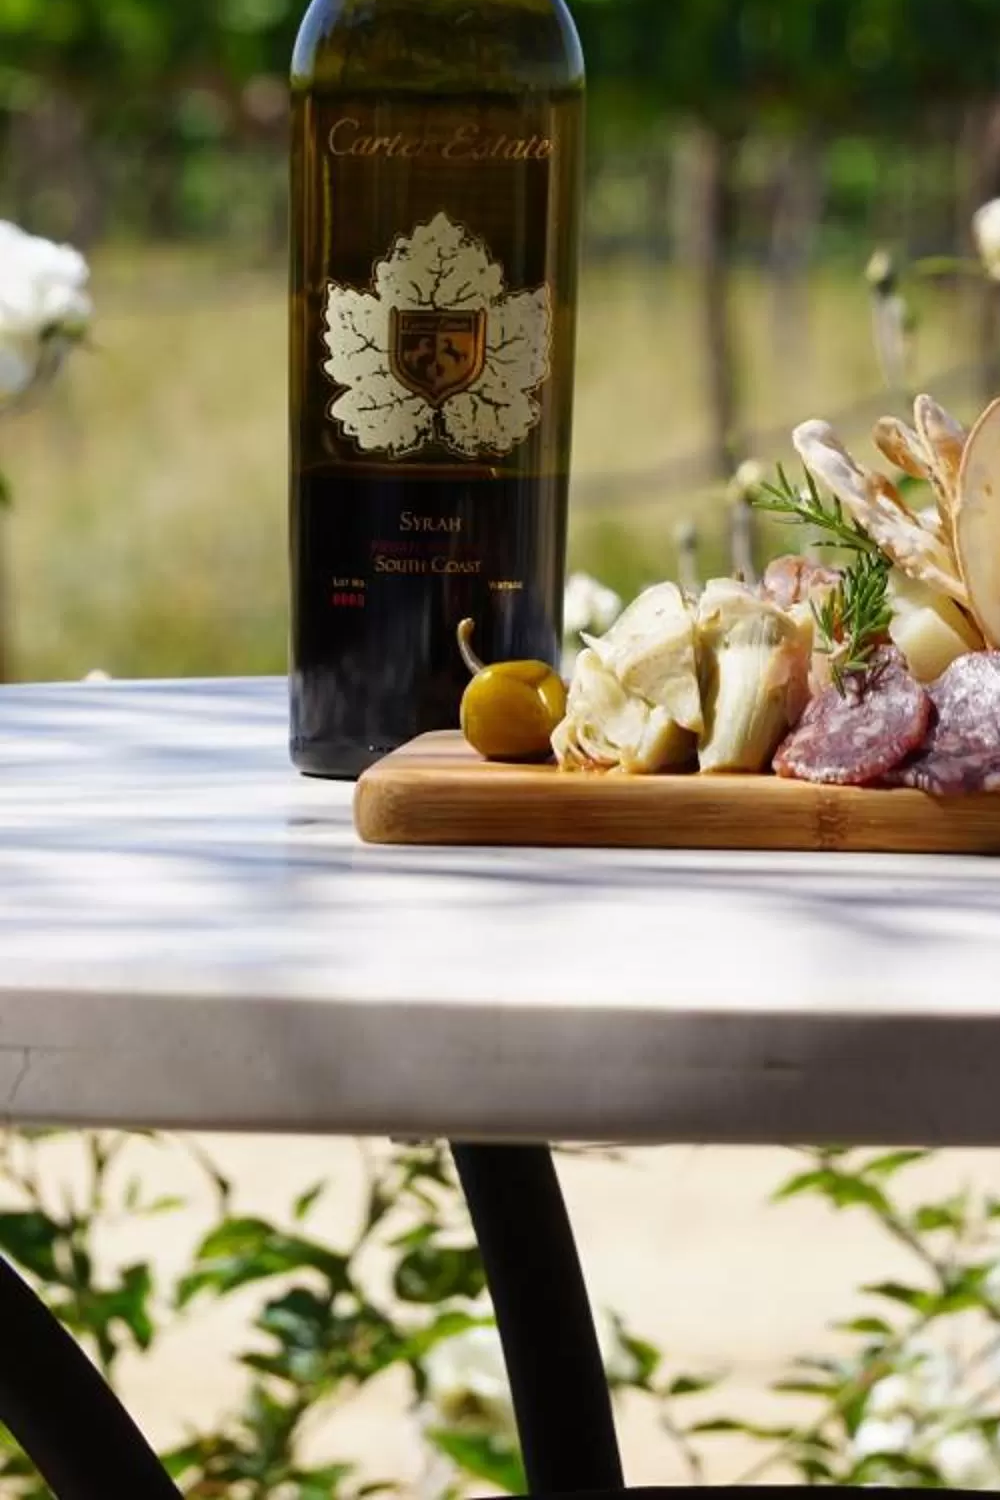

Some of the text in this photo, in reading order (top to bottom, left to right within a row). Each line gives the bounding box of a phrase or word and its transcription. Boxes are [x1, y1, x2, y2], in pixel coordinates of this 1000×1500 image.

[328, 116, 557, 161] Carter Estate
[399, 511, 462, 533] SYRAH
[375, 554, 483, 574] SOUTH COAST
